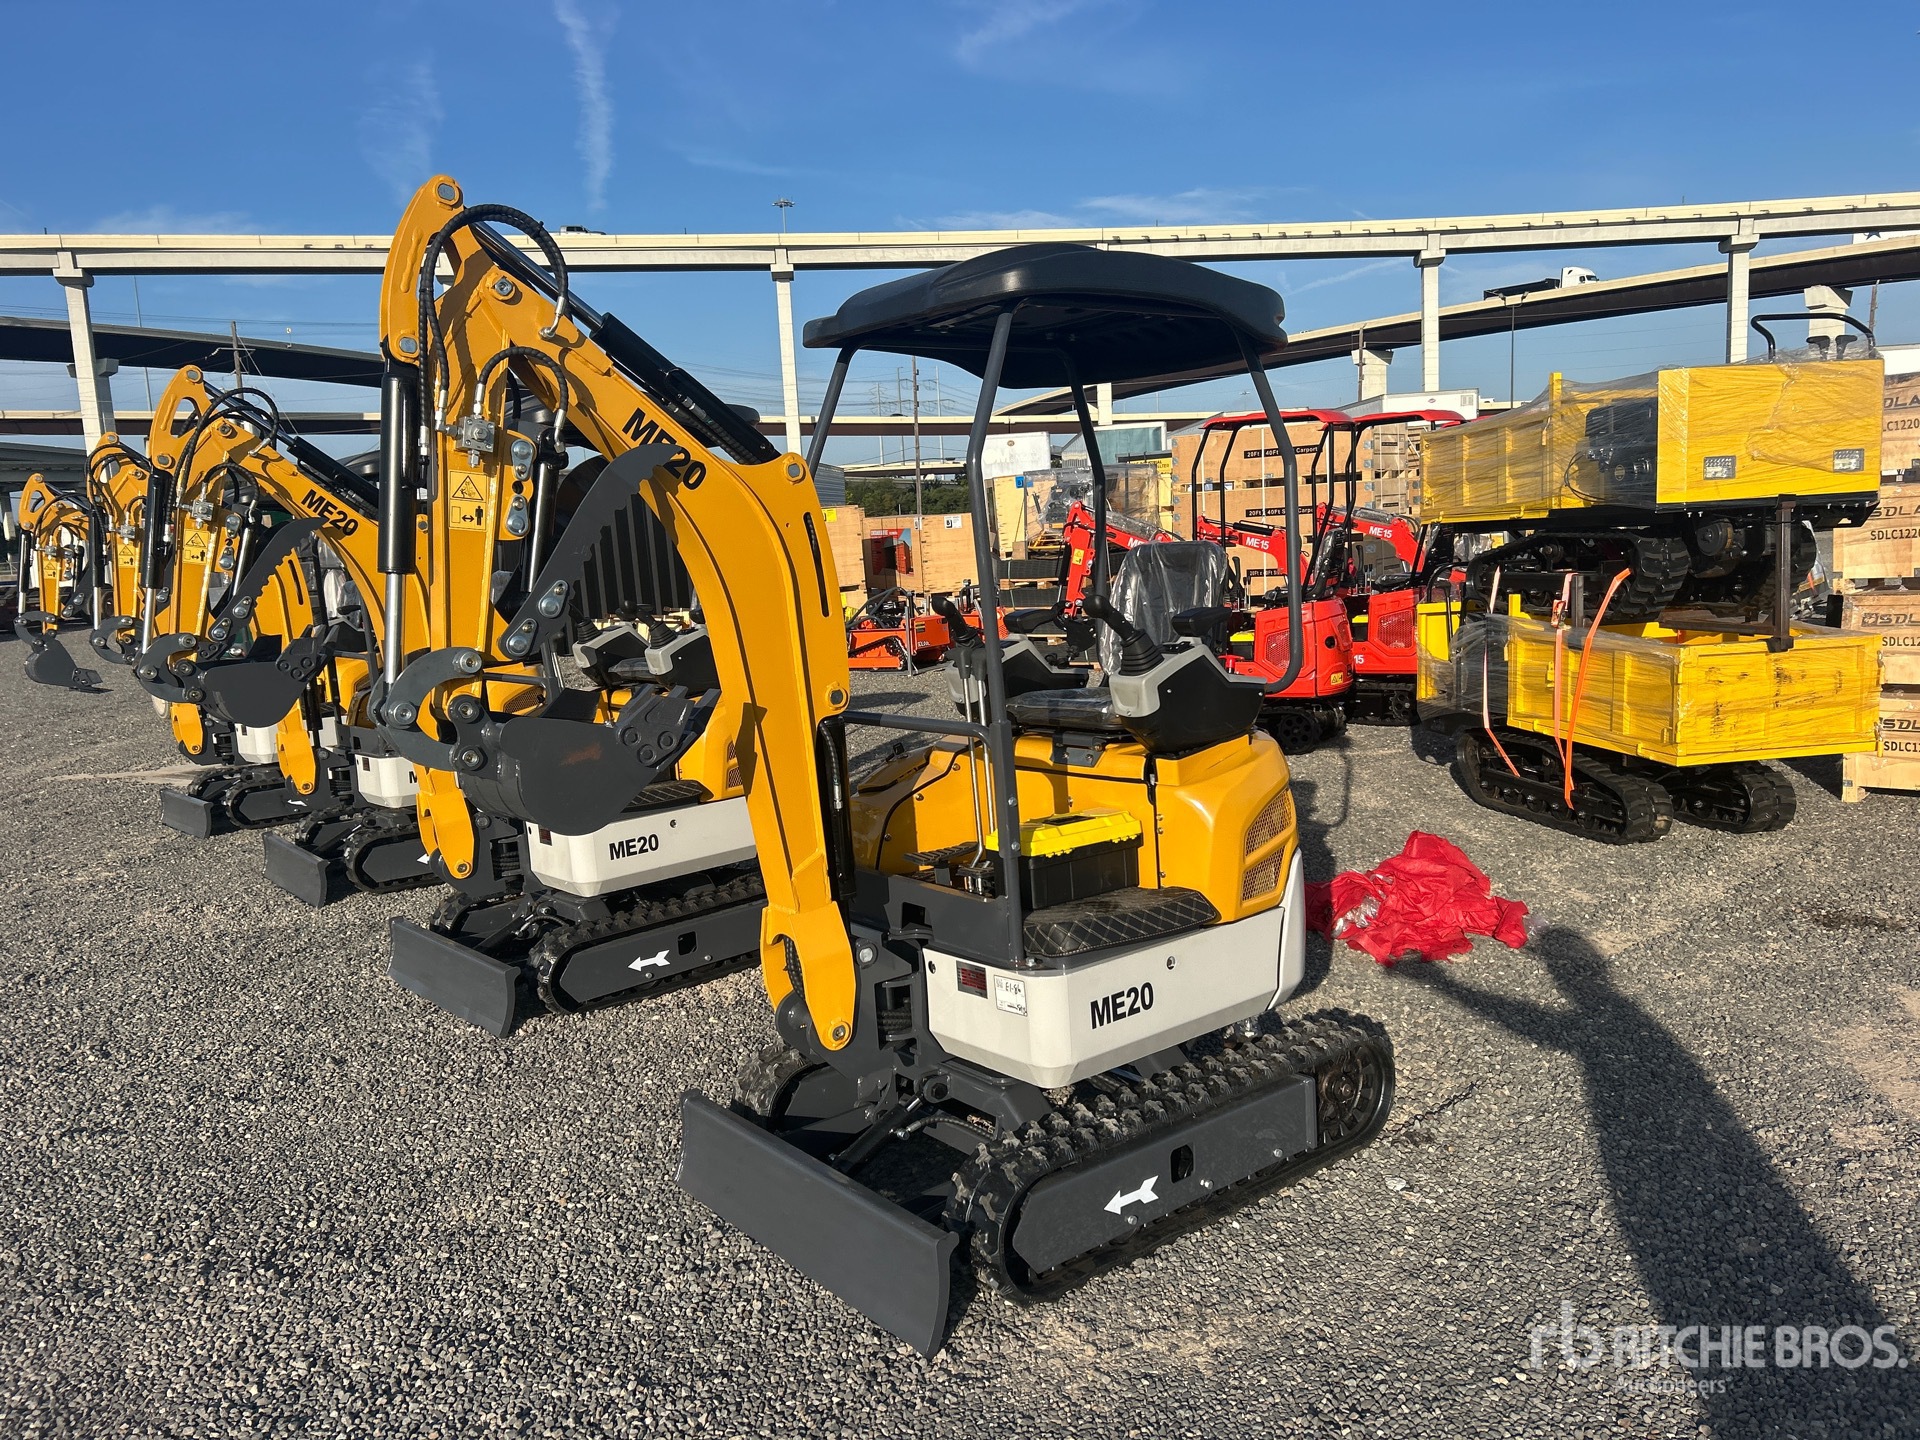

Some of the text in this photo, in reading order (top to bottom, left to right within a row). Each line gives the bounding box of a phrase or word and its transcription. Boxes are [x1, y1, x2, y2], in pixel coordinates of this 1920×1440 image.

[1884, 395, 1920, 408] DLA
[1883, 418, 1920, 431] C1220
[1296, 446, 1318, 454] Carport
[301, 489, 359, 536] ME20
[1369, 526, 1393, 539] ME15
[1870, 528, 1920, 541] SDLC122
[1245, 536, 1270, 550] ME15
[1353, 654, 1365, 665] 15
[1884, 741, 1920, 752] SDLC1
[609, 834, 659, 860] ME20
[1090, 981, 1154, 1029] ME20
